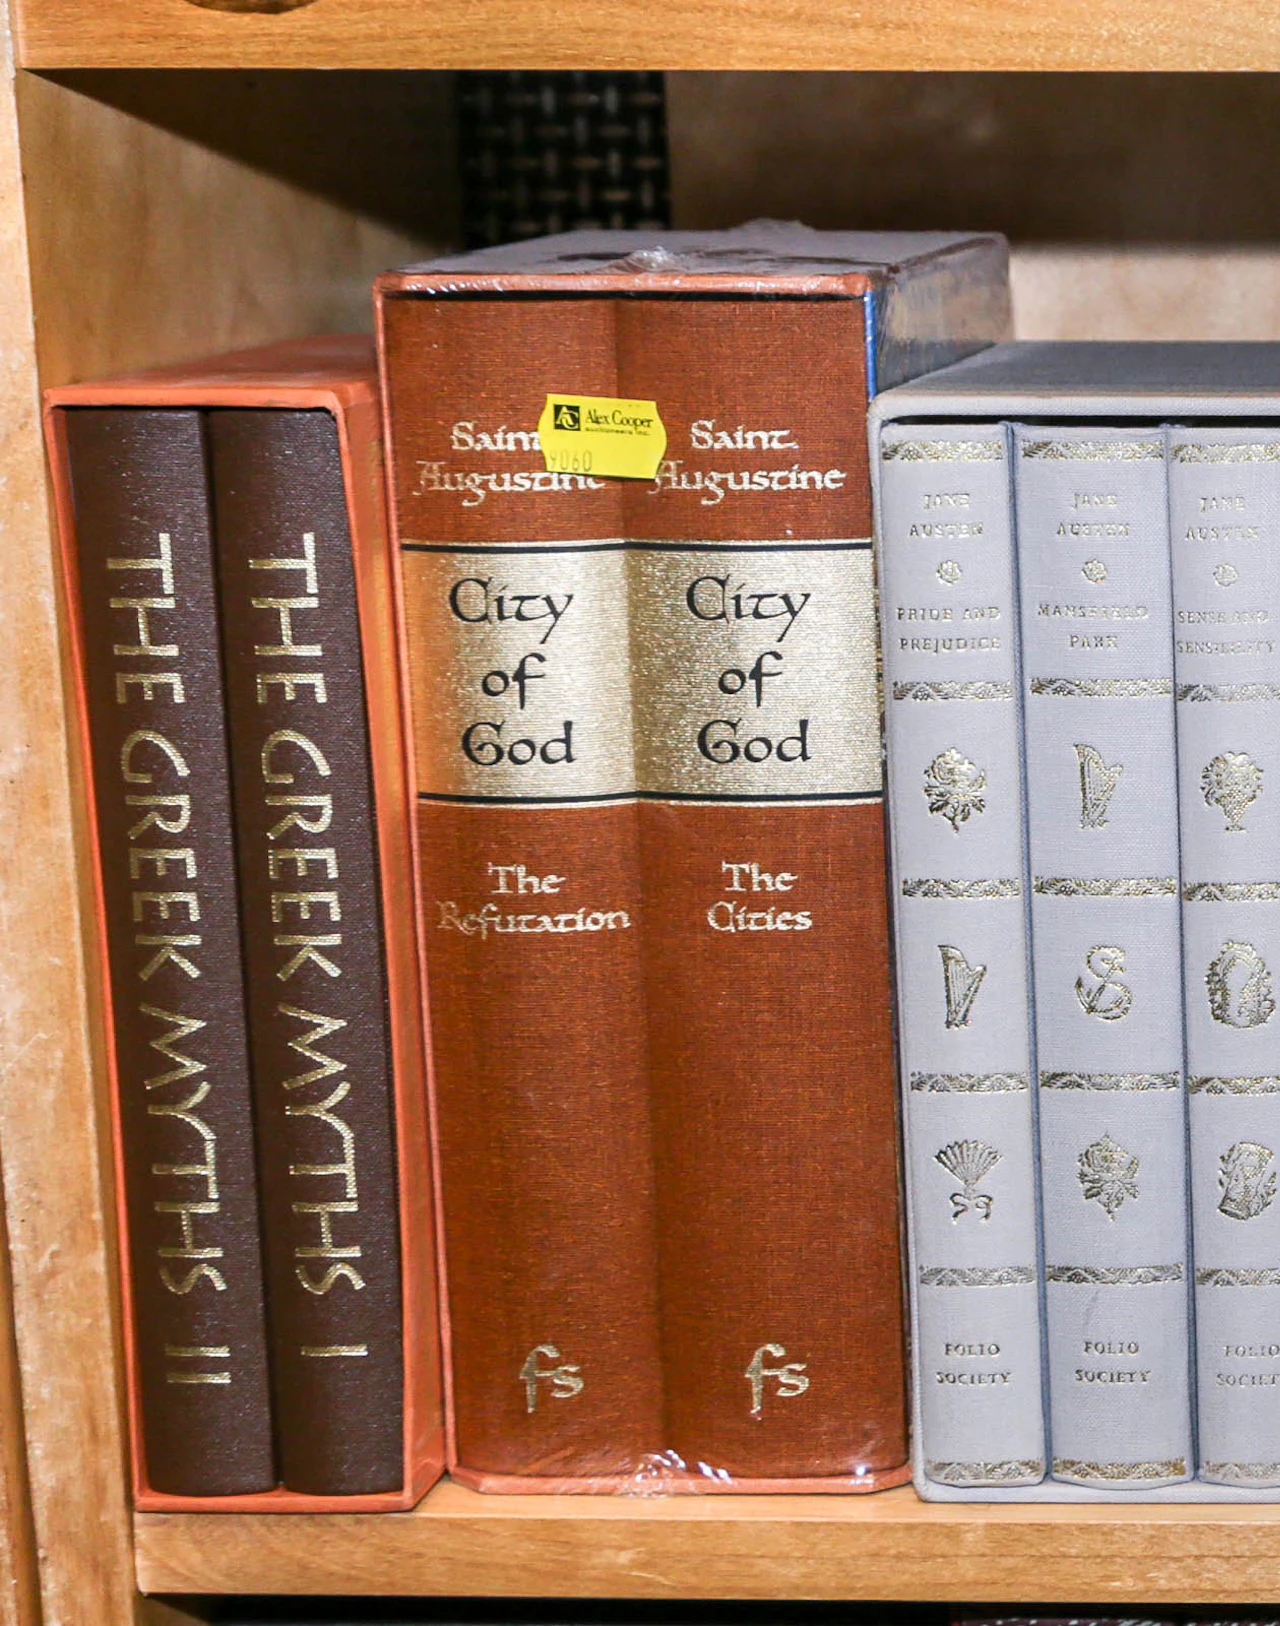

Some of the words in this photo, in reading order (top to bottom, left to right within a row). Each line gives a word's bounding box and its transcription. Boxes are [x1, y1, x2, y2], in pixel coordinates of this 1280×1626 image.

[586, 409, 611, 425] Alex
[612, 410, 654, 429] Cooper
[689, 419, 800, 450] Saint
[647, 460, 847, 506] Augustine
[1200, 496, 1246, 512] JANE
[910, 523, 984, 538] AUSTEN
[107, 533, 184, 704] THE
[249, 533, 327, 704] THE
[448, 576, 574, 644] City
[686, 574, 811, 643] City
[897, 607, 953, 622] PRIDE
[900, 637, 1001, 655] PREJUDICE
[481, 652, 546, 709] of
[718, 650, 783, 708] of
[461, 720, 576, 766] God
[697, 718, 812, 764] God
[119, 731, 201, 982] GREEK
[261, 731, 343, 982] GREEK
[487, 861, 566, 894] The
[722, 860, 798, 892] The
[436, 900, 631, 940] Refutation
[707, 900, 812, 933] Cities
[140, 1003, 227, 1295] MYTHS
[277, 1003, 366, 1295] MYTHS
[164, 1344, 231, 1385] II
[301, 1344, 368, 1357] I
[944, 1342, 1000, 1357] FOLIO
[1083, 1341, 1140, 1356] FOLIO
[1224, 1343, 1280, 1358] FOLIO
[936, 1371, 1012, 1386] SOCIETY
[1074, 1369, 1151, 1384] SOCIETY
